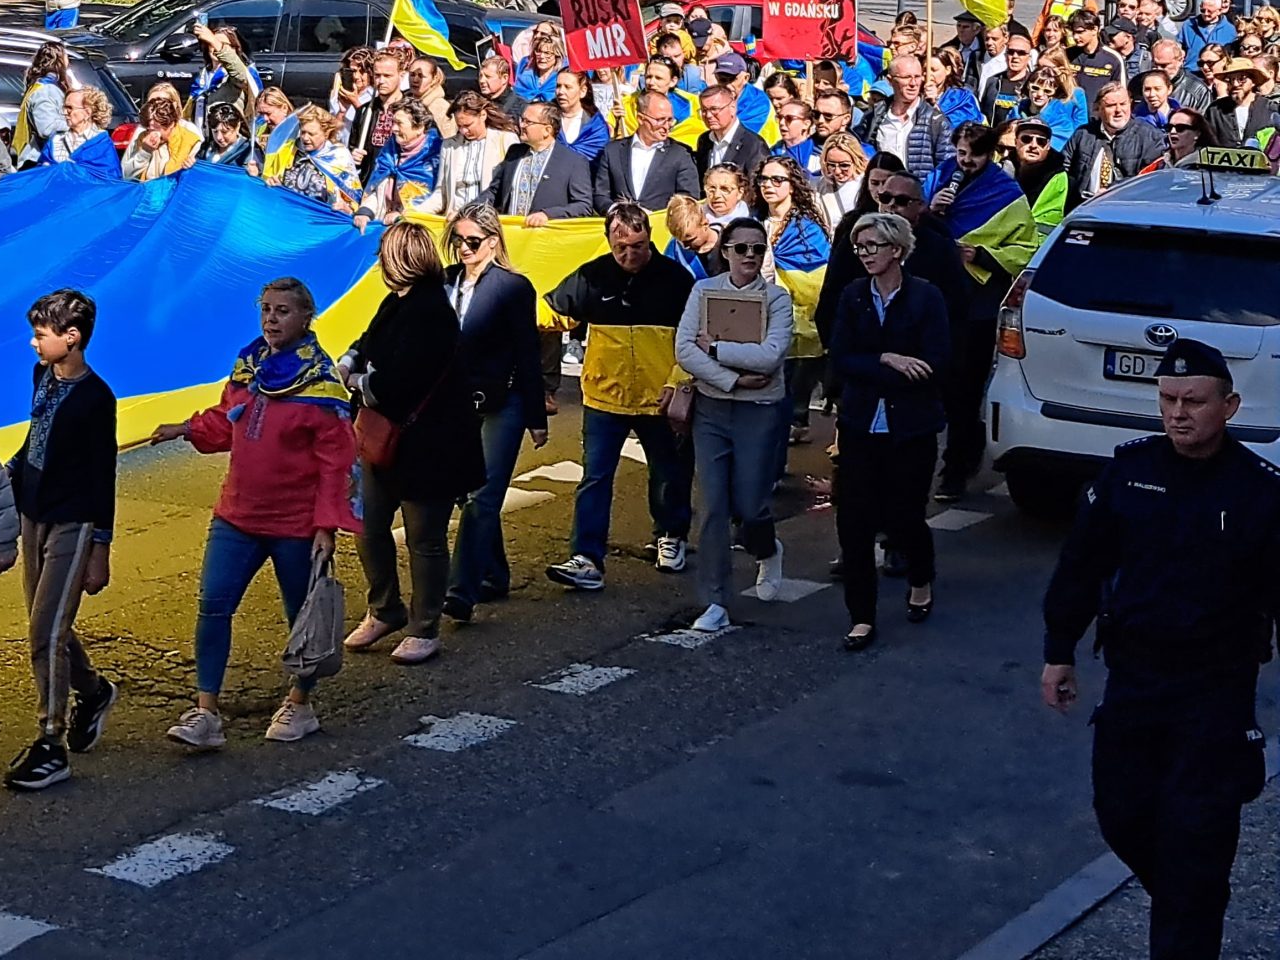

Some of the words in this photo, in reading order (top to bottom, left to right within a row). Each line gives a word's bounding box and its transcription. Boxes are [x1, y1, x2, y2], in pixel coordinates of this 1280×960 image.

[768, 1, 780, 16] W
[784, 0, 839, 19] GDAŃSKU
[586, 23, 631, 60] MIR
[1208, 151, 1256, 168] TAXI
[1120, 354, 1146, 375] GD
